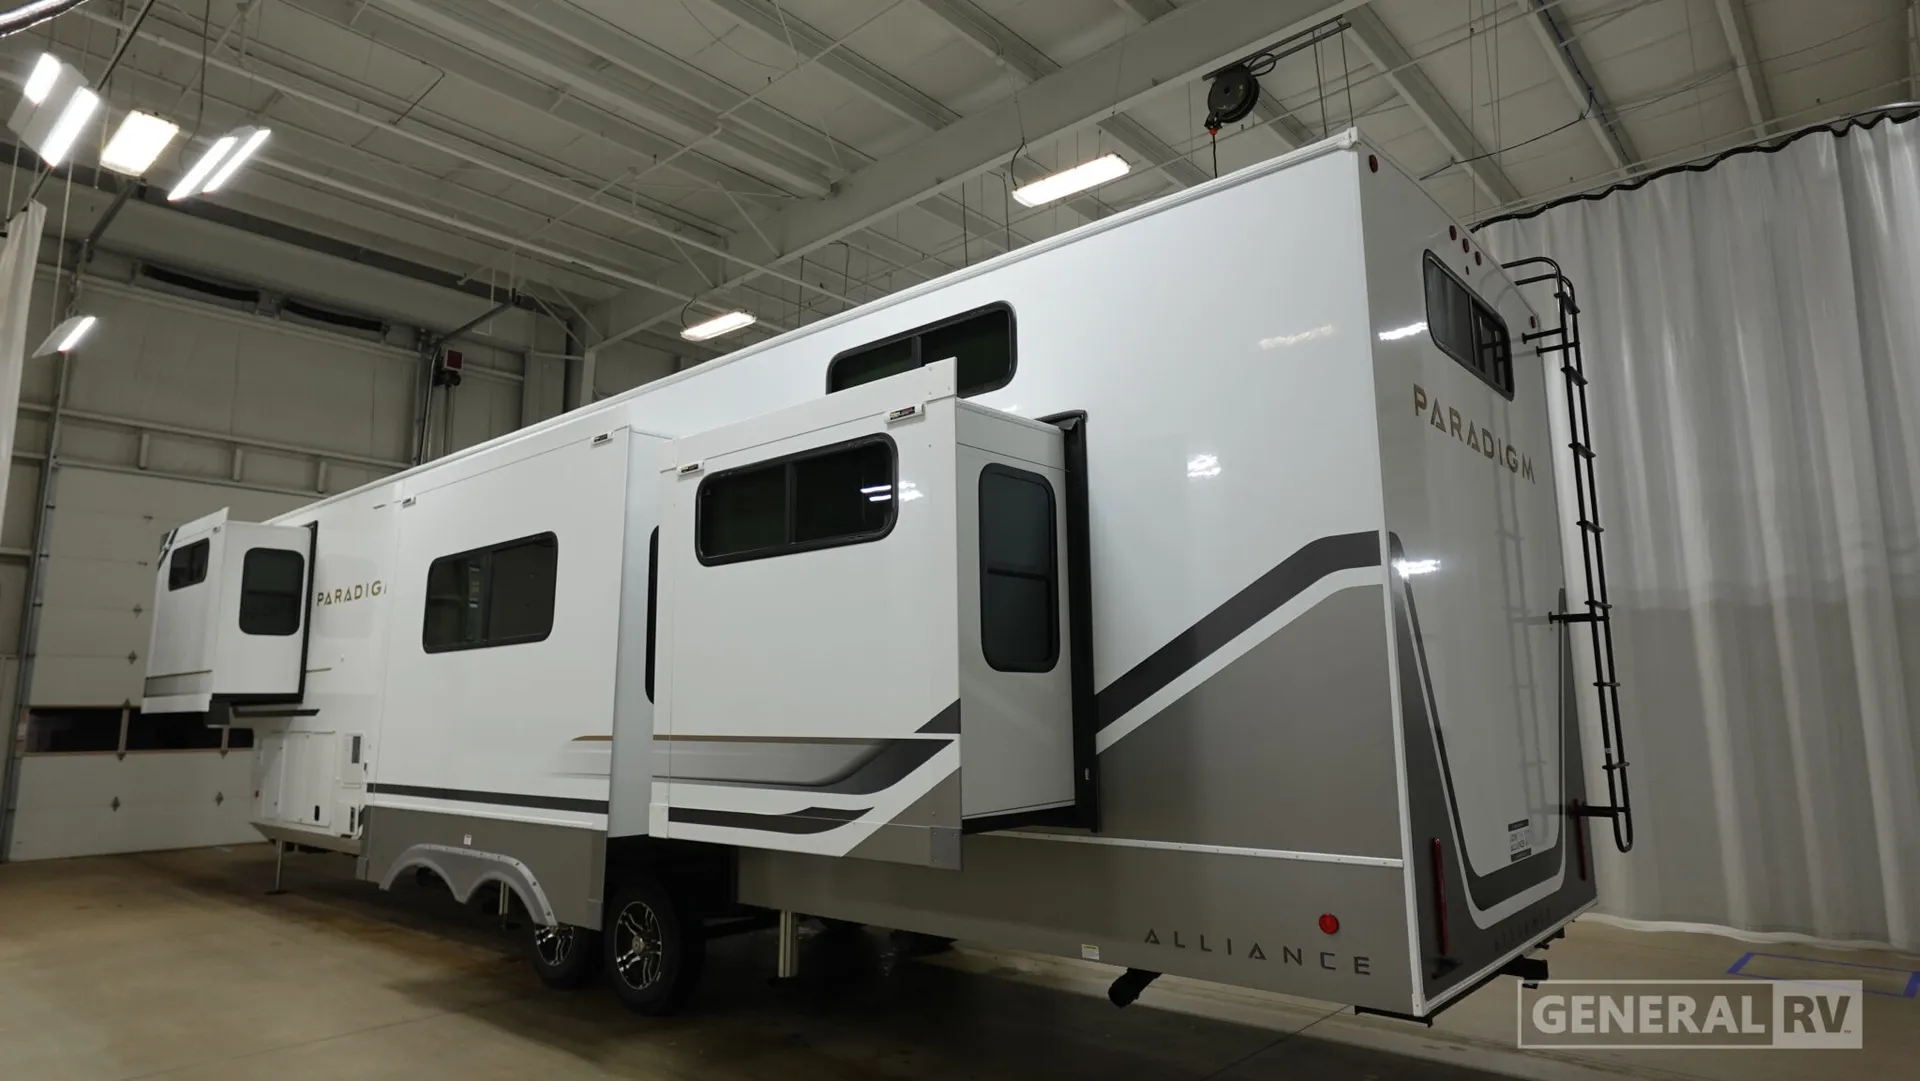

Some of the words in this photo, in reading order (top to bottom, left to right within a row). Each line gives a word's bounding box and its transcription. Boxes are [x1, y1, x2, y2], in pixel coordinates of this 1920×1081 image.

[1413, 383, 1536, 485] PARADIGM
[316, 580, 387, 607] PARADIG
[1144, 928, 1371, 976] ALLIANCE
